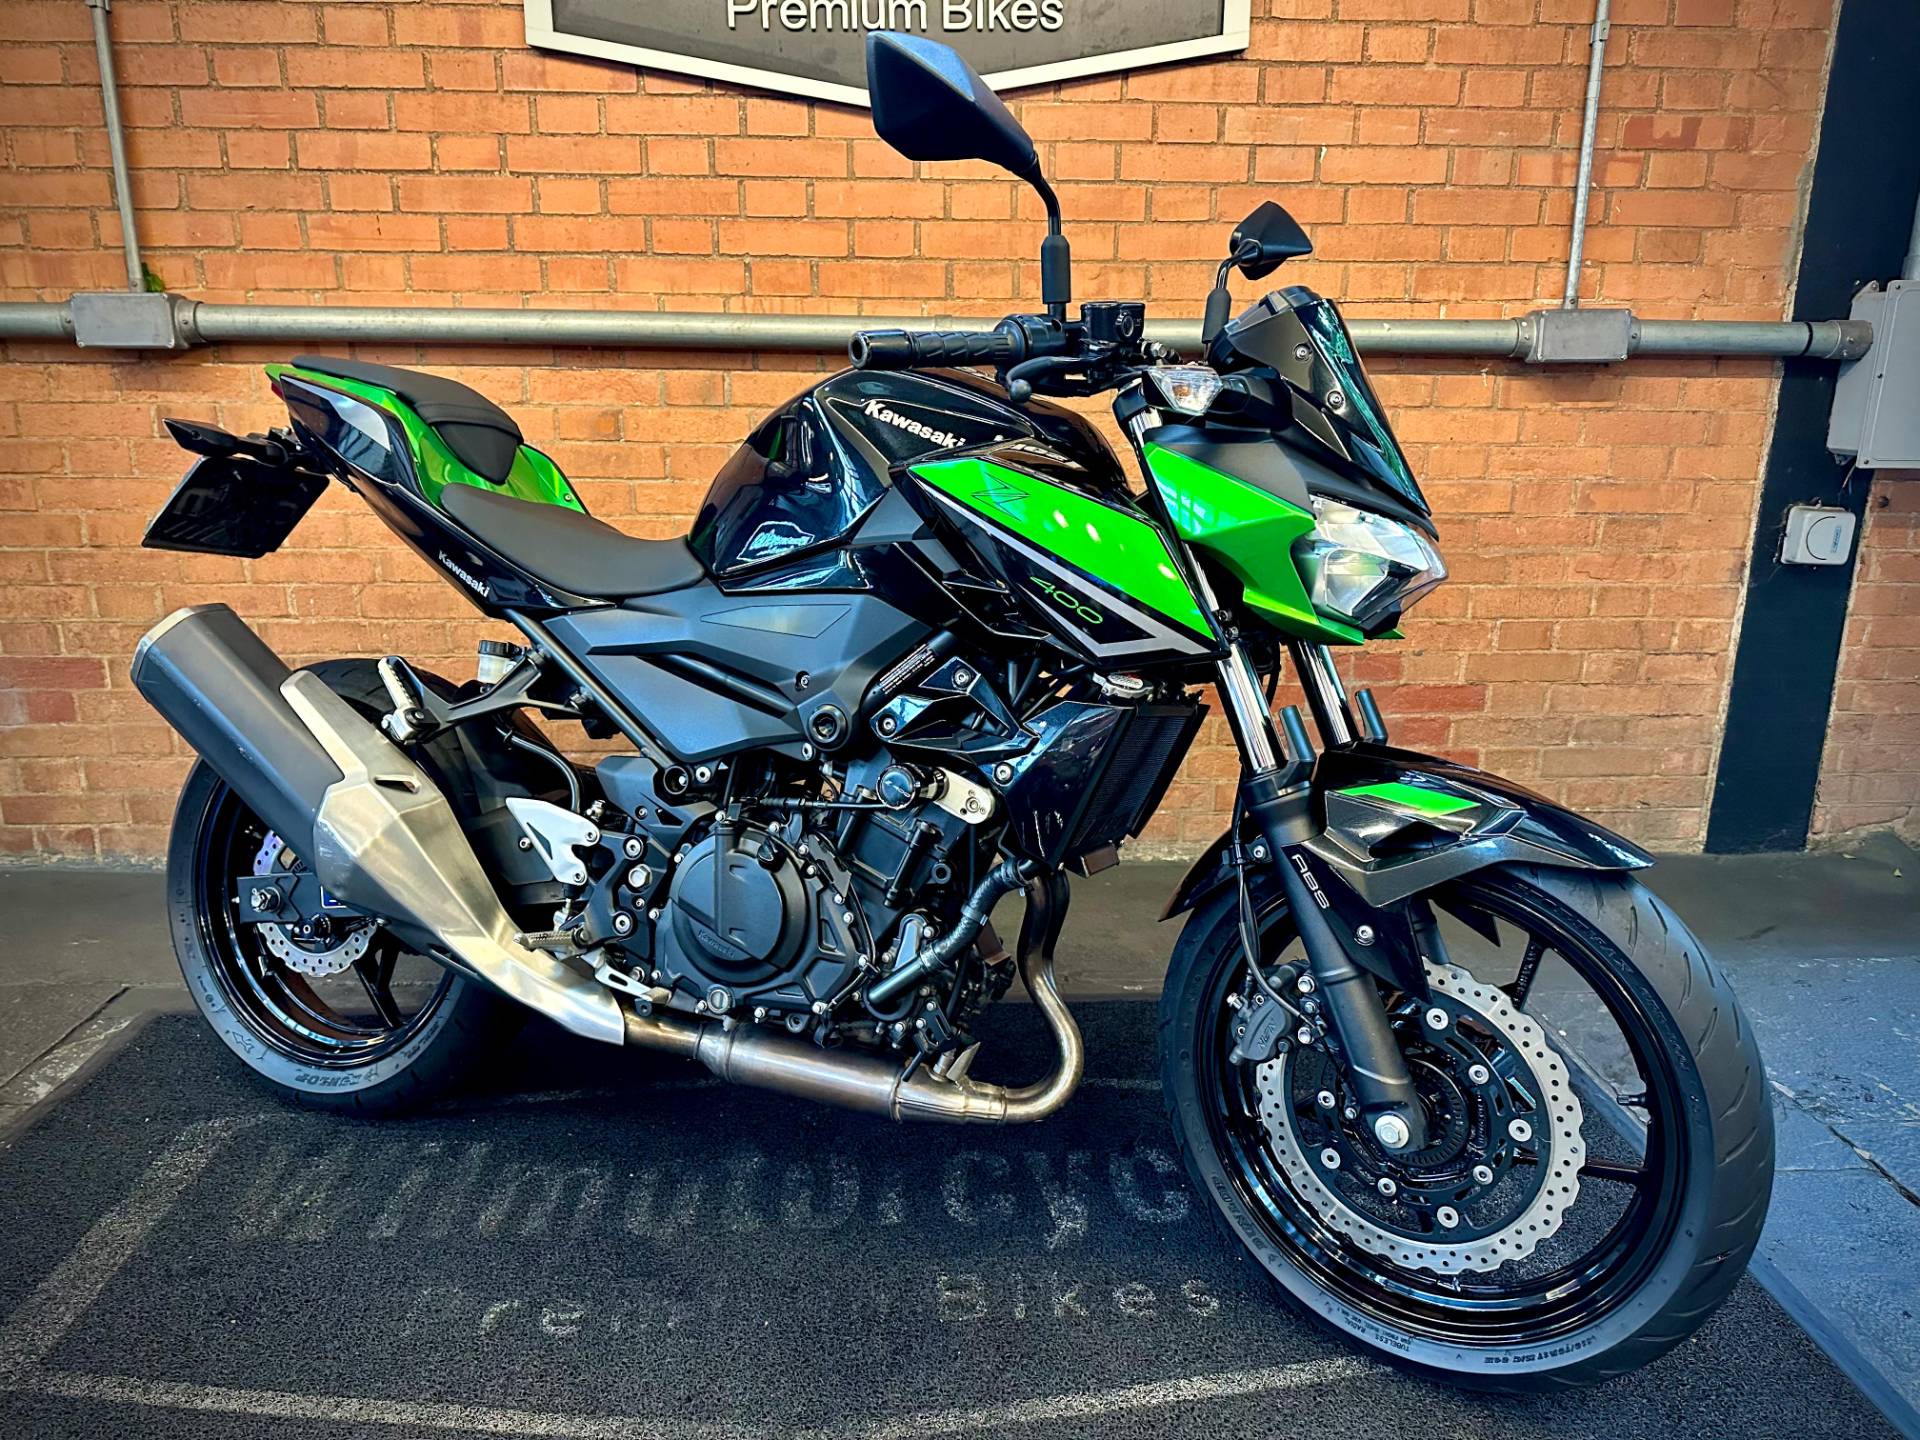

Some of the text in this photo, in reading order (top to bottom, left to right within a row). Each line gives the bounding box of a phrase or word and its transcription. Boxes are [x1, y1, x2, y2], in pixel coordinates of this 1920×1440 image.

[726, 0, 1065, 31] Premium Bikes
[864, 400, 967, 449] Kawasaki
[438, 549, 490, 598] Kawasaki
[1029, 575, 1104, 625] 400
[1291, 853, 1330, 909] ABS
